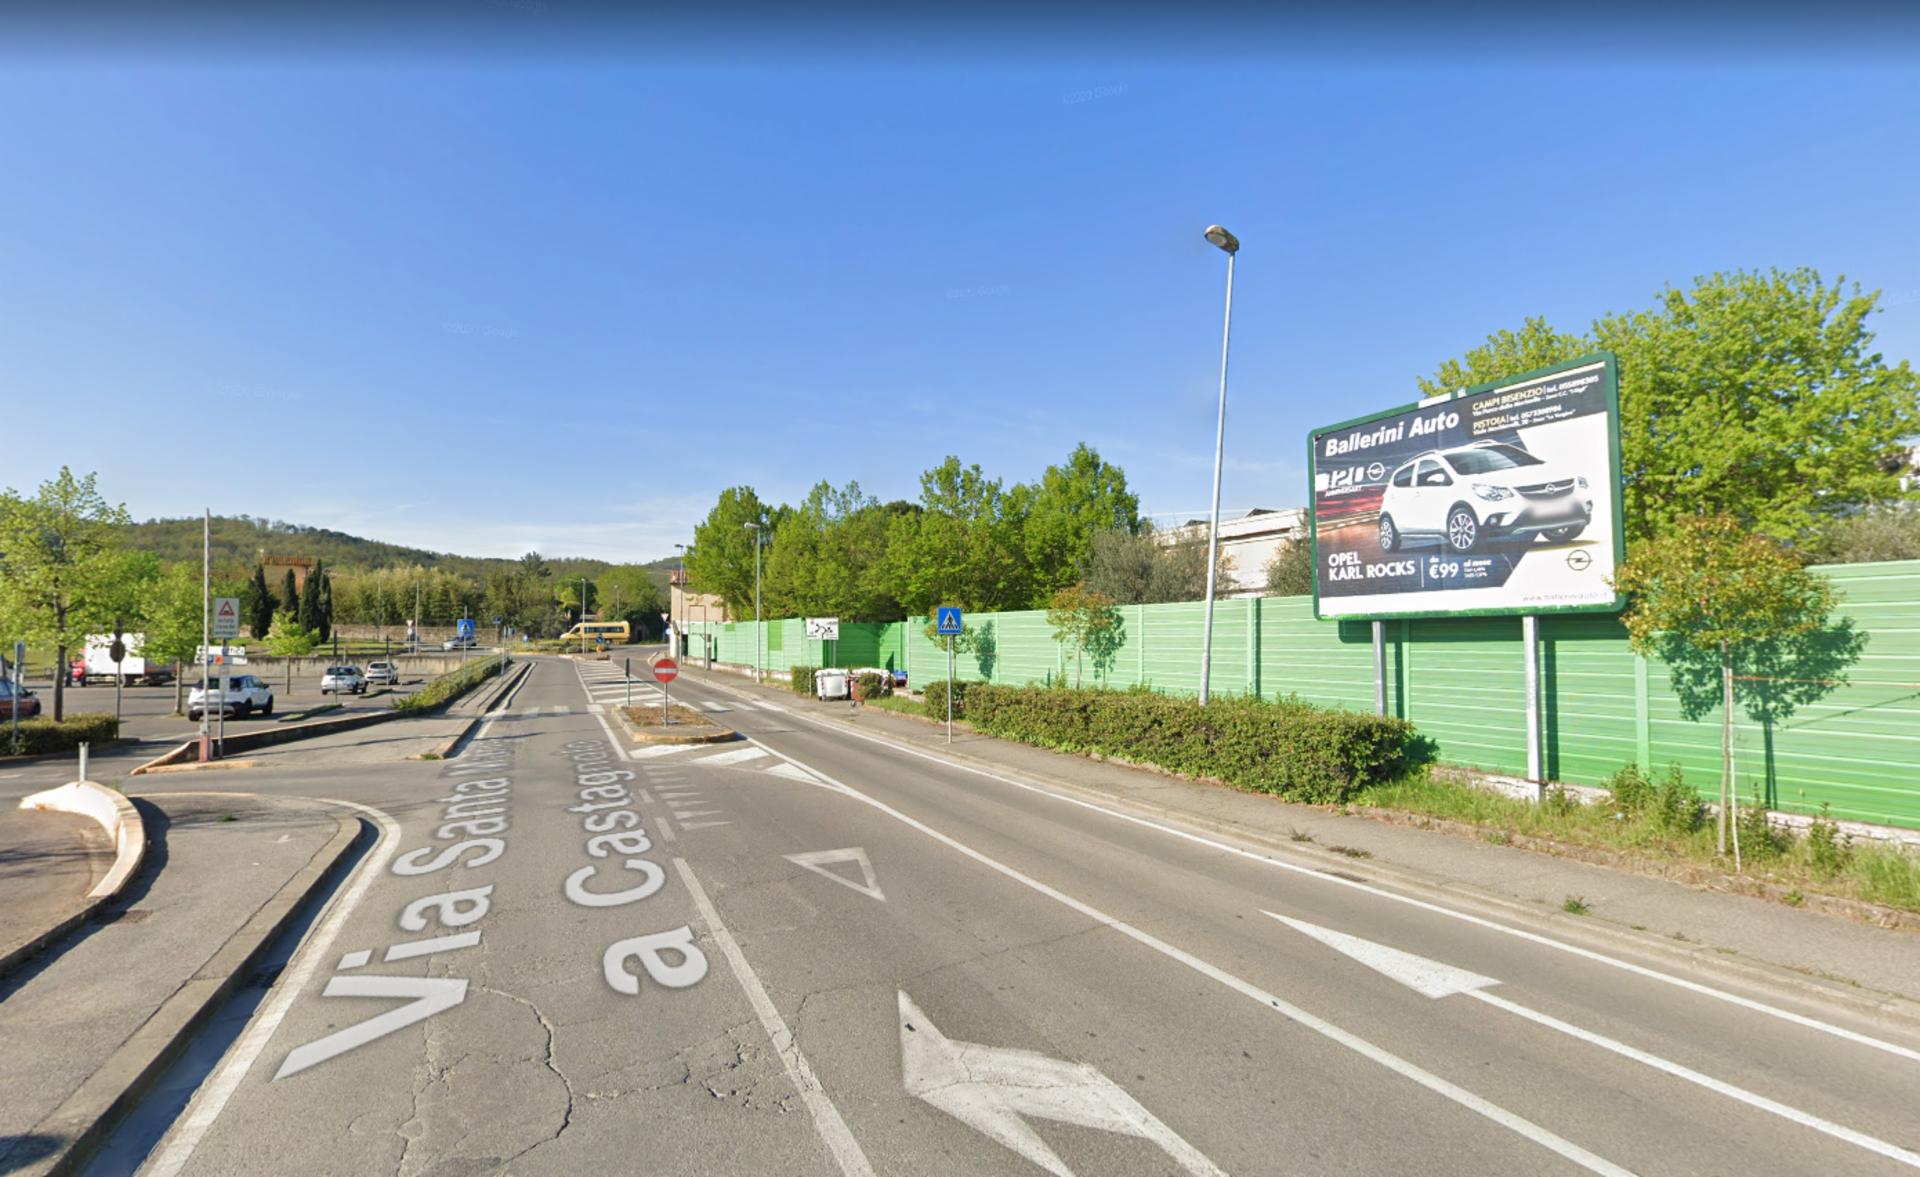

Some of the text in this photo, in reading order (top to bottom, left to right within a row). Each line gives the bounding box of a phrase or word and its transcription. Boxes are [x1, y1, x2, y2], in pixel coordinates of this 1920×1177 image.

[1325, 412, 1460, 457] Ballerini Auto
[1328, 551, 1362, 567] OPEL
[1328, 560, 1416, 581] KARL ROCKS
[1429, 562, 1459, 579] €99
